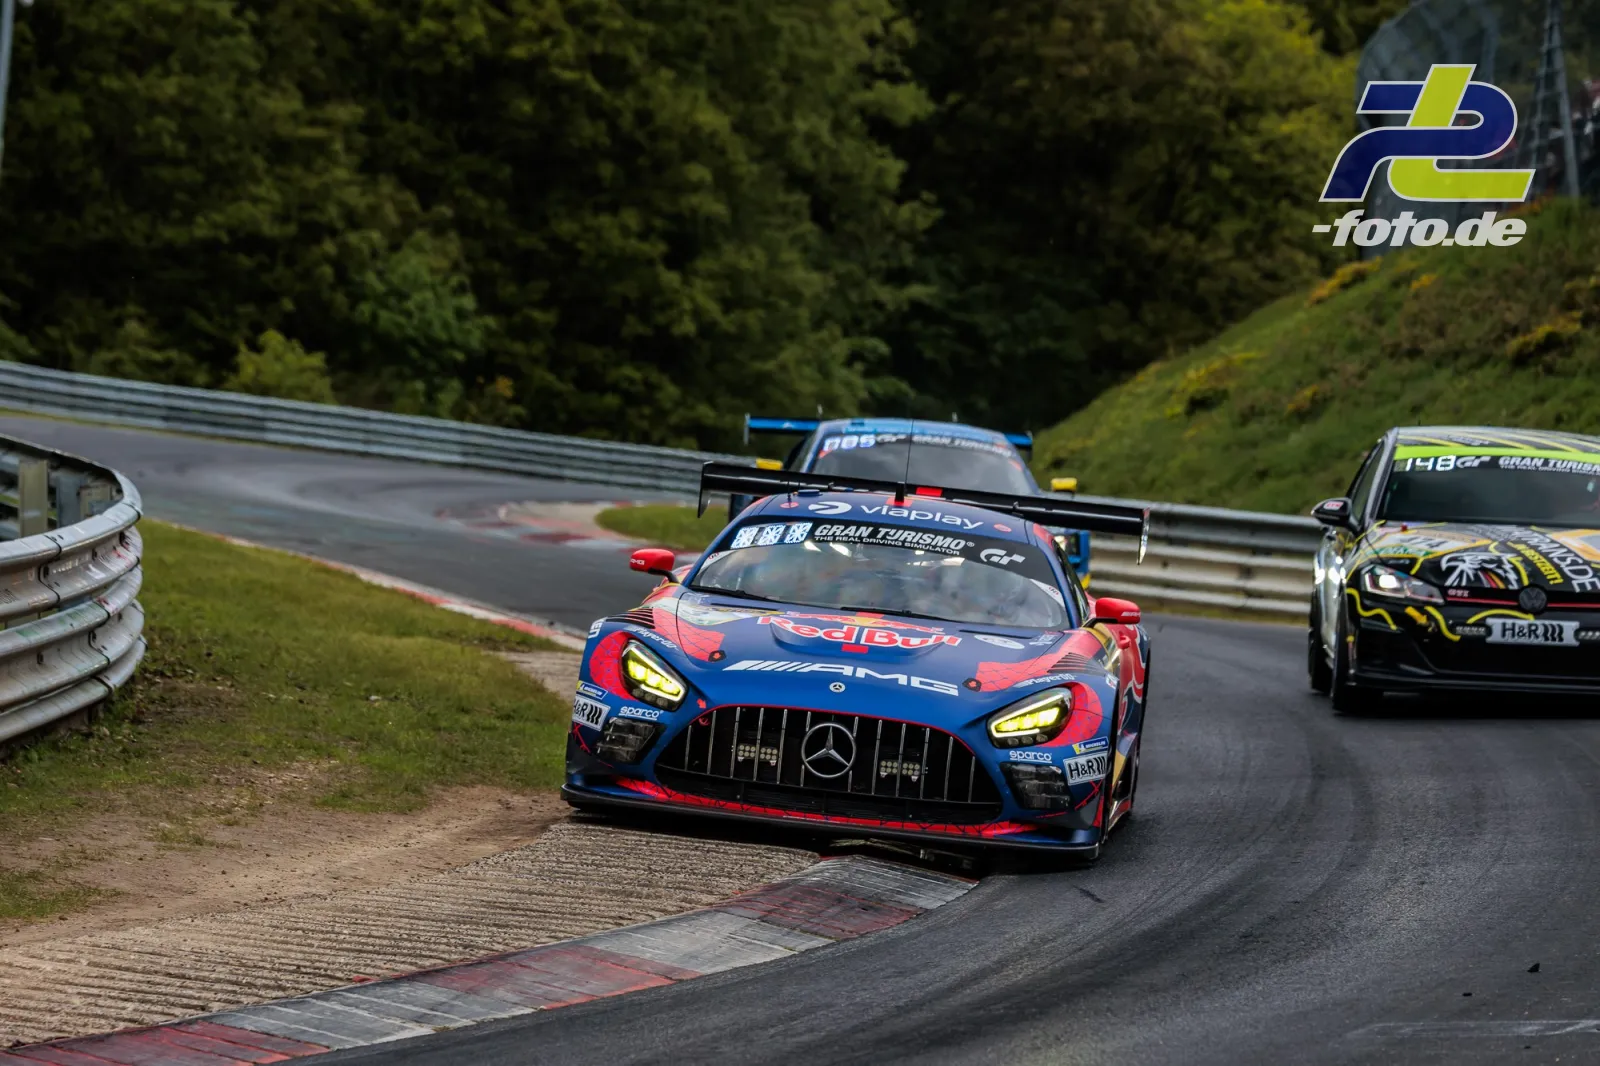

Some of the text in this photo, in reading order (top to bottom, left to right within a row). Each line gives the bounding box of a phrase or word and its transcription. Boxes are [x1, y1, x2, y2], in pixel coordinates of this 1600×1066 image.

[1405, 455, 1457, 471] 148
[1499, 456, 1545, 467] GRAN
[860, 504, 984, 530] viaplay
[814, 524, 870, 538] GRAN
[862, 538, 903, 546] DRIVING
[904, 542, 960, 556] SIMULATOR
[757, 616, 857, 643] Red
[861, 628, 962, 649] Bull
[1501, 622, 1540, 640] H&R
[797, 662, 959, 697] AMG
[619, 705, 660, 719] sparco
[1009, 750, 1052, 761] sparco
[1068, 759, 1097, 779] H&R
